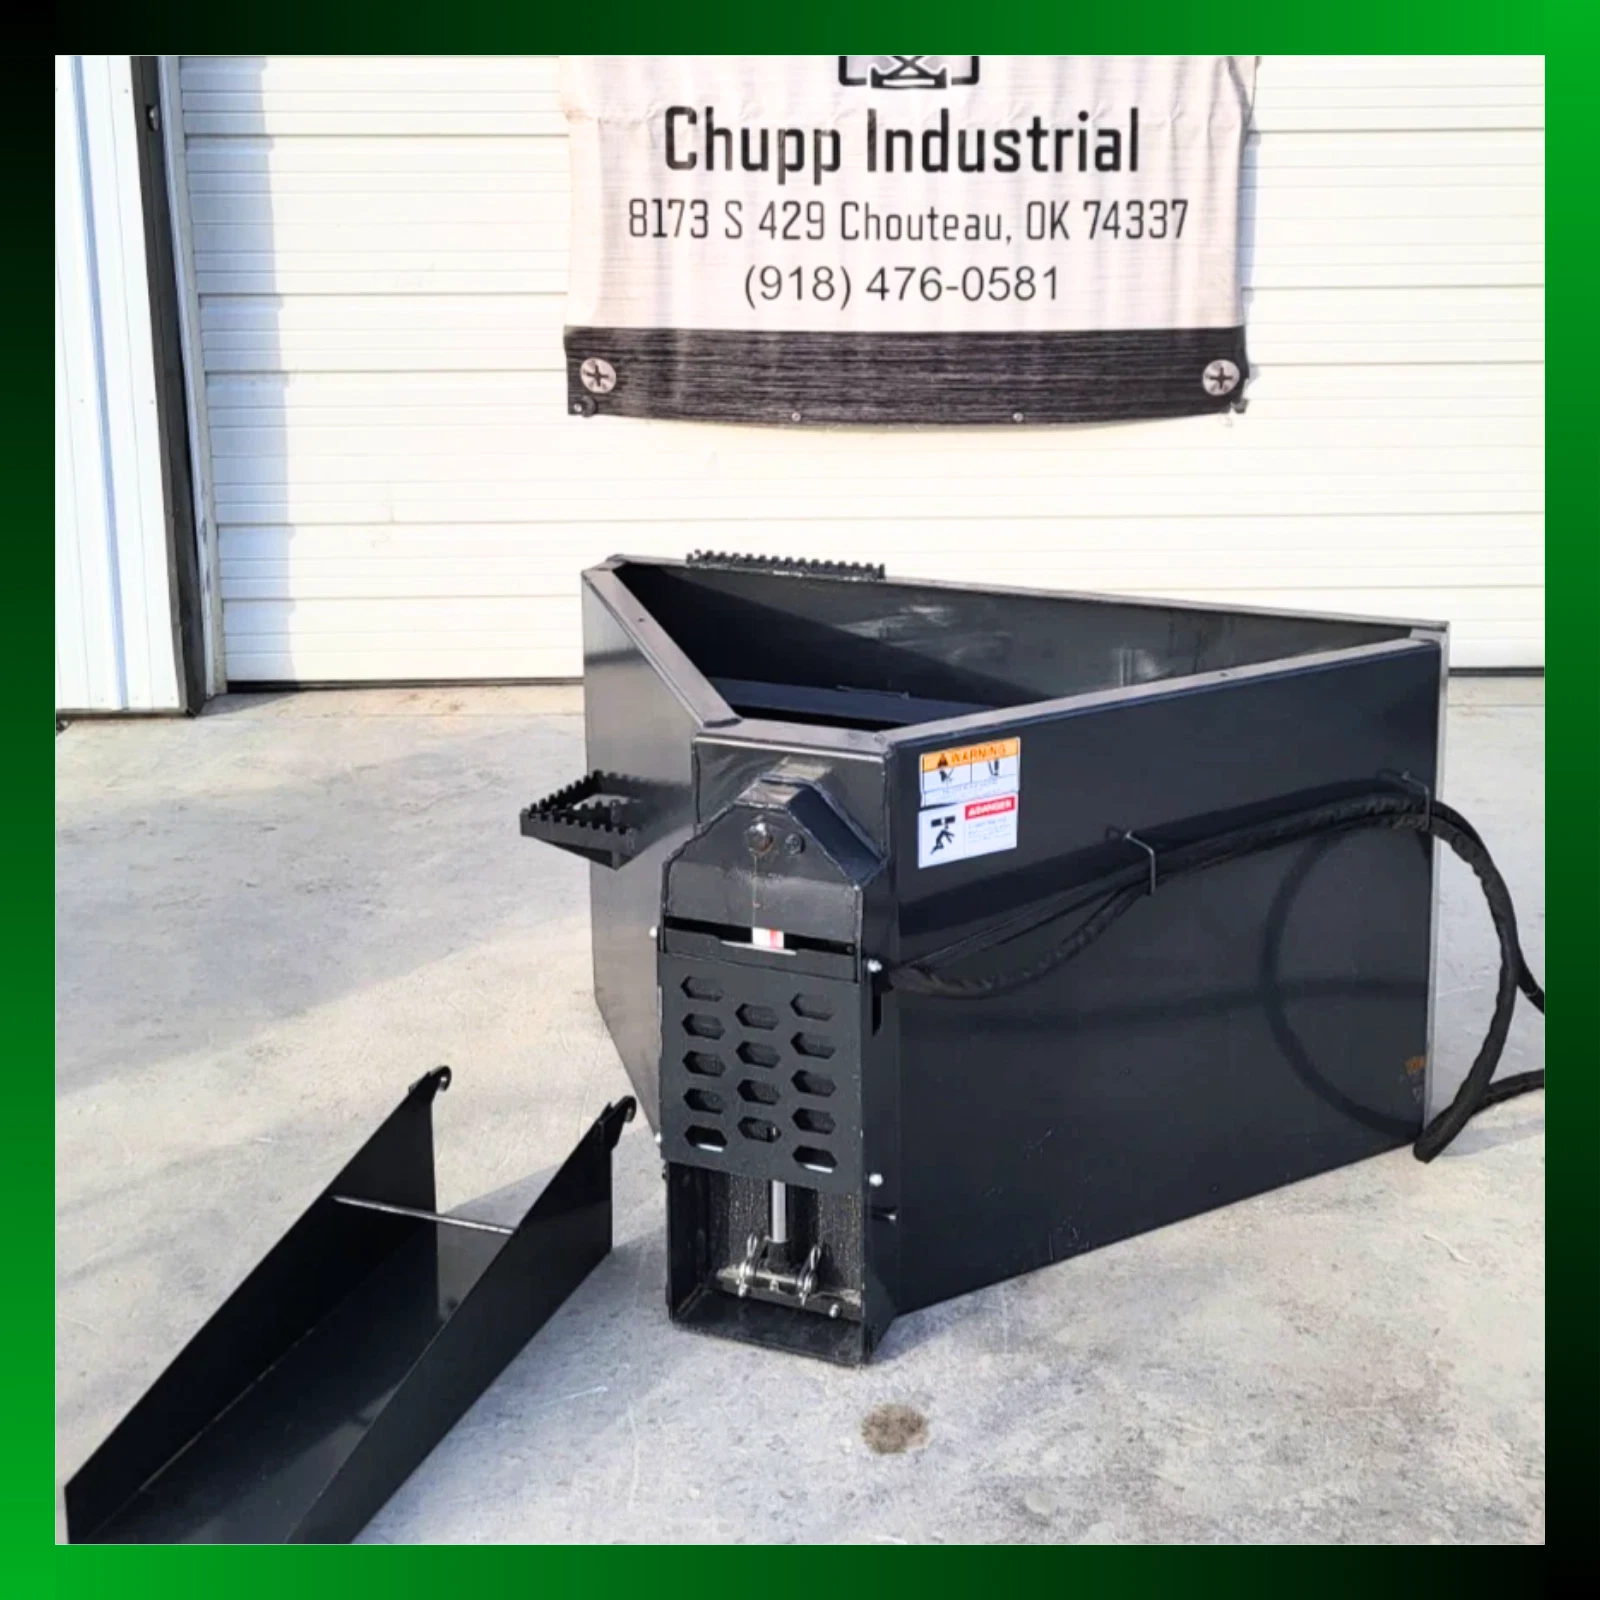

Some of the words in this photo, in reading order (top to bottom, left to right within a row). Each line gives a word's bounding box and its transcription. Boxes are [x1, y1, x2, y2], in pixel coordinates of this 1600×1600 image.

[664, 105, 841, 186] Chupp
[867, 106, 1140, 173] Industrial
[628, 198, 709, 239] 8173
[724, 199, 743, 239] S
[758, 199, 825, 240] 429
[840, 200, 1012, 243] Chouteau,
[1025, 200, 1069, 240] OK
[1083, 199, 1189, 240] 74337
[744, 265, 852, 309] (918)
[865, 265, 1059, 302] 476-0581
[951, 744, 1006, 763] WARNING
[975, 799, 1012, 814] DANGER
